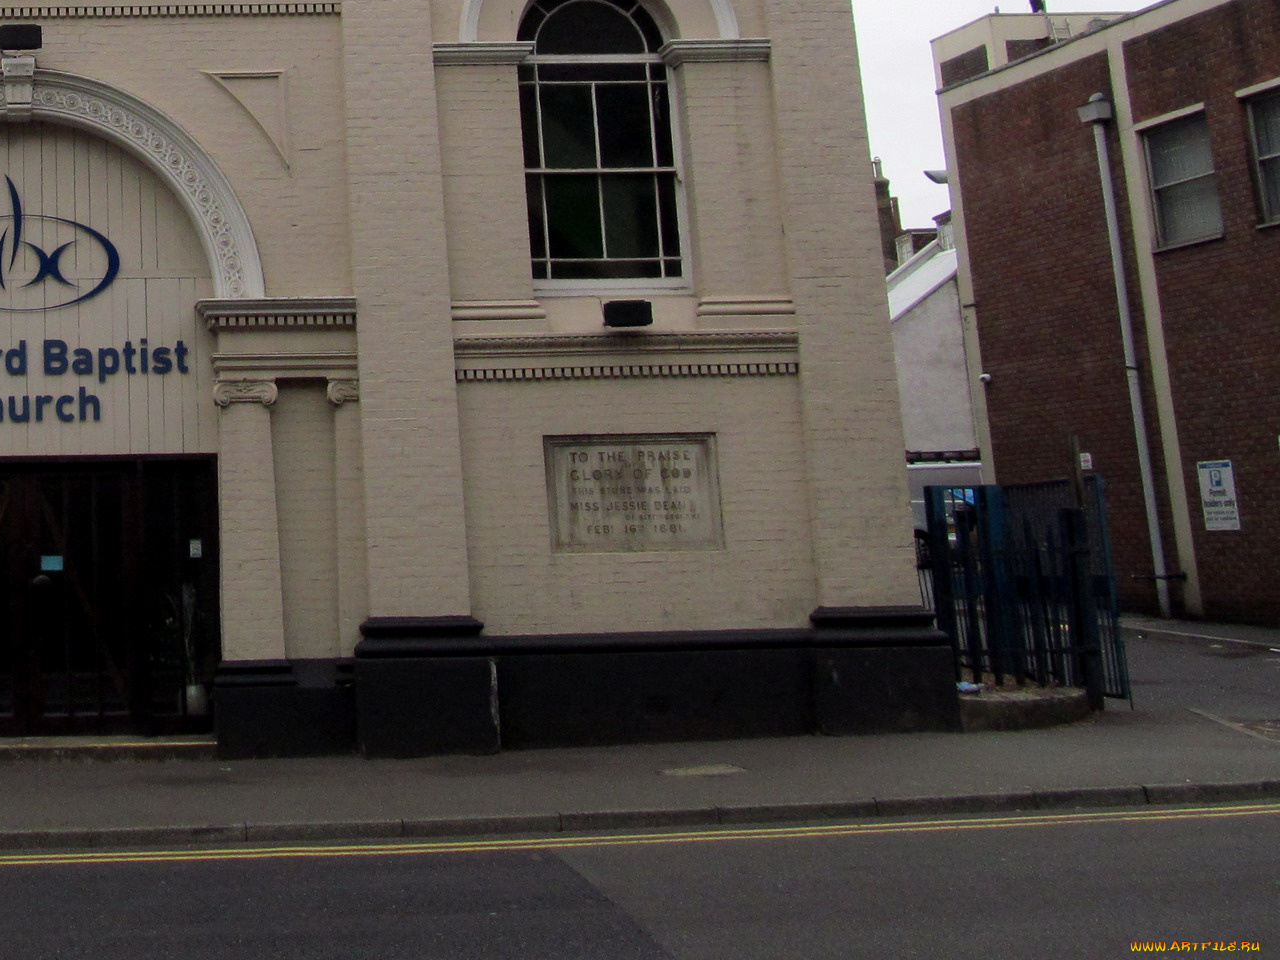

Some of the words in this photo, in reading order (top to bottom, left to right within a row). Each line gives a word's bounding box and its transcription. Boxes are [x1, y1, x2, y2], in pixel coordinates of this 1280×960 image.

[43, 338, 189, 383] Baptist
[569, 451, 589, 463] TO
[597, 450, 625, 463] THE
[637, 449, 692, 462] PRAISE
[570, 468, 624, 481] GLORY
[606, 501, 648, 512] JESSIE
